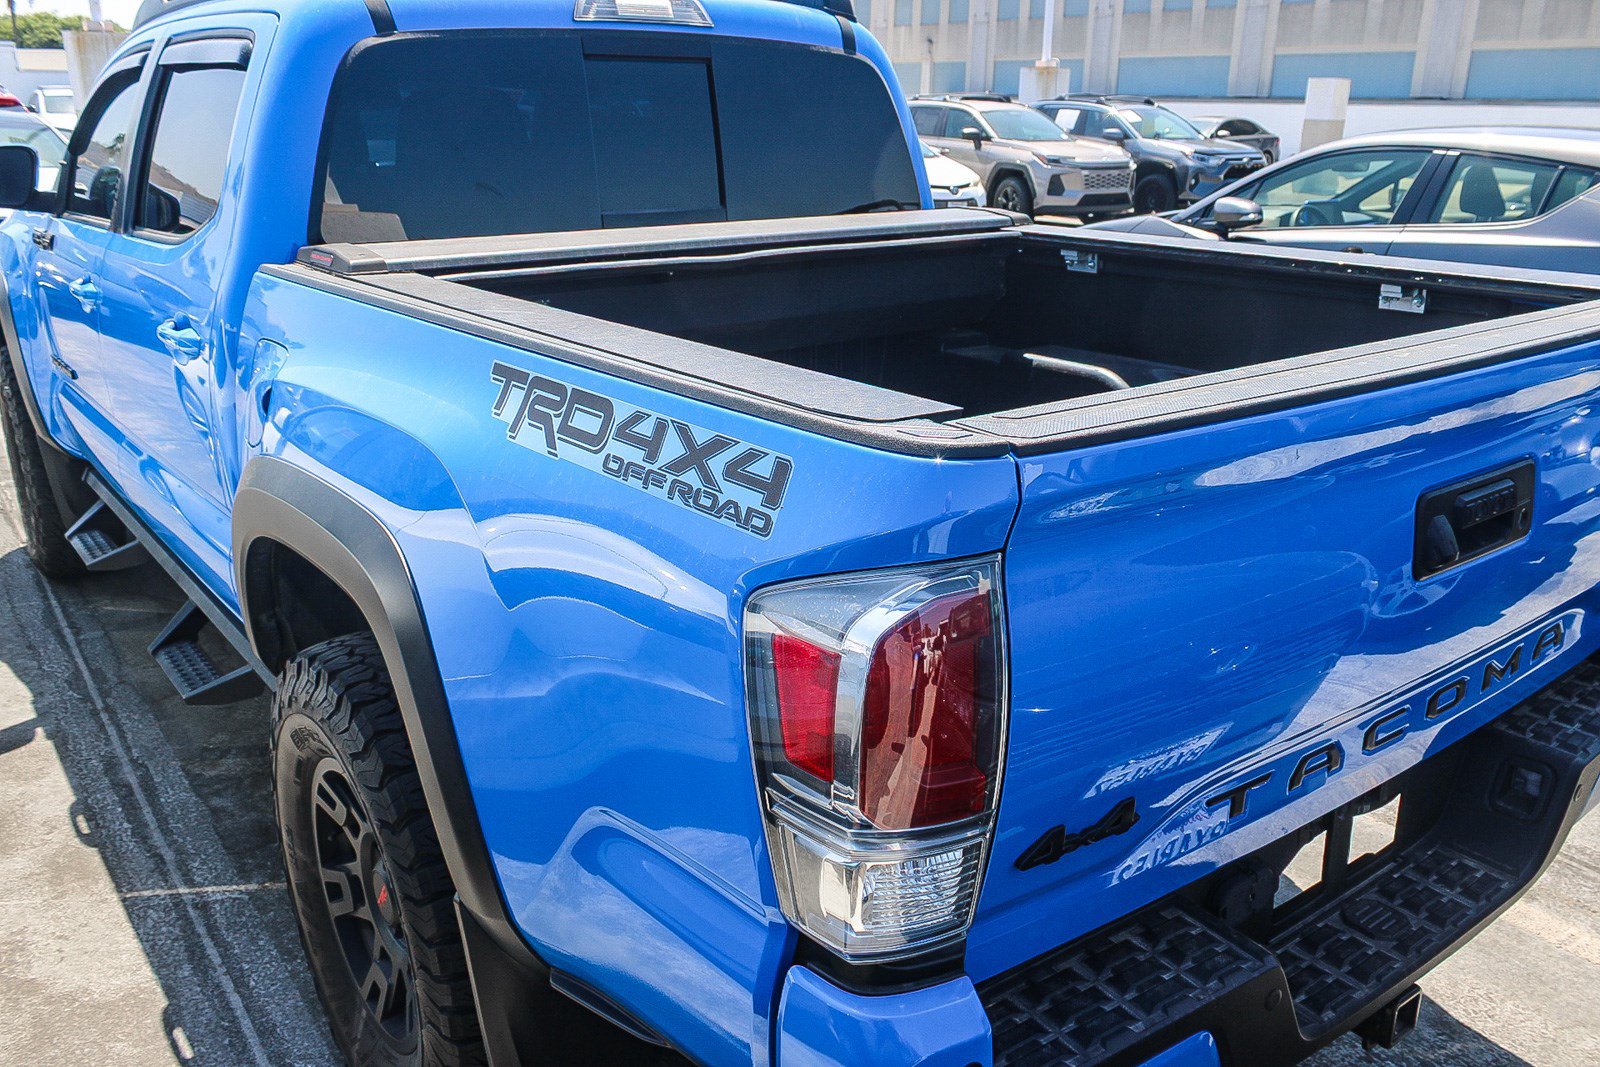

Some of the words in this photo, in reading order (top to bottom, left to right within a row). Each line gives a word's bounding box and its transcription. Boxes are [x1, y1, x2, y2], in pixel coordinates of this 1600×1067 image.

[491, 361, 616, 458] TRD
[602, 453, 668, 490] OFF
[667, 479, 774, 538] ROAD
[1204, 620, 1566, 819] TACOMA
